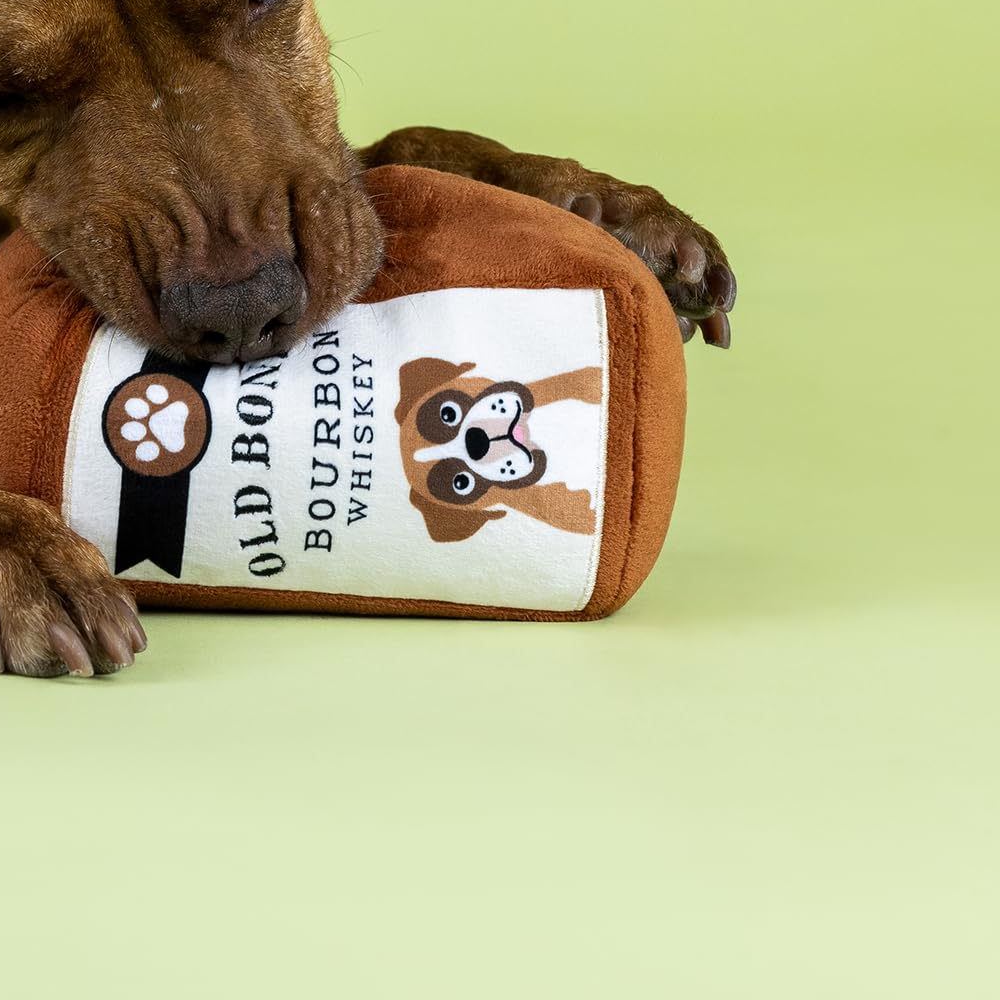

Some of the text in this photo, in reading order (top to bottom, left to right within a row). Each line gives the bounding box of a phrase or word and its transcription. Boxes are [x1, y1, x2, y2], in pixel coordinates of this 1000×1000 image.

[231, 351, 289, 578] OLD BON
[303, 330, 342, 553] BOURBON
[347, 353, 375, 527] WHISKEY
